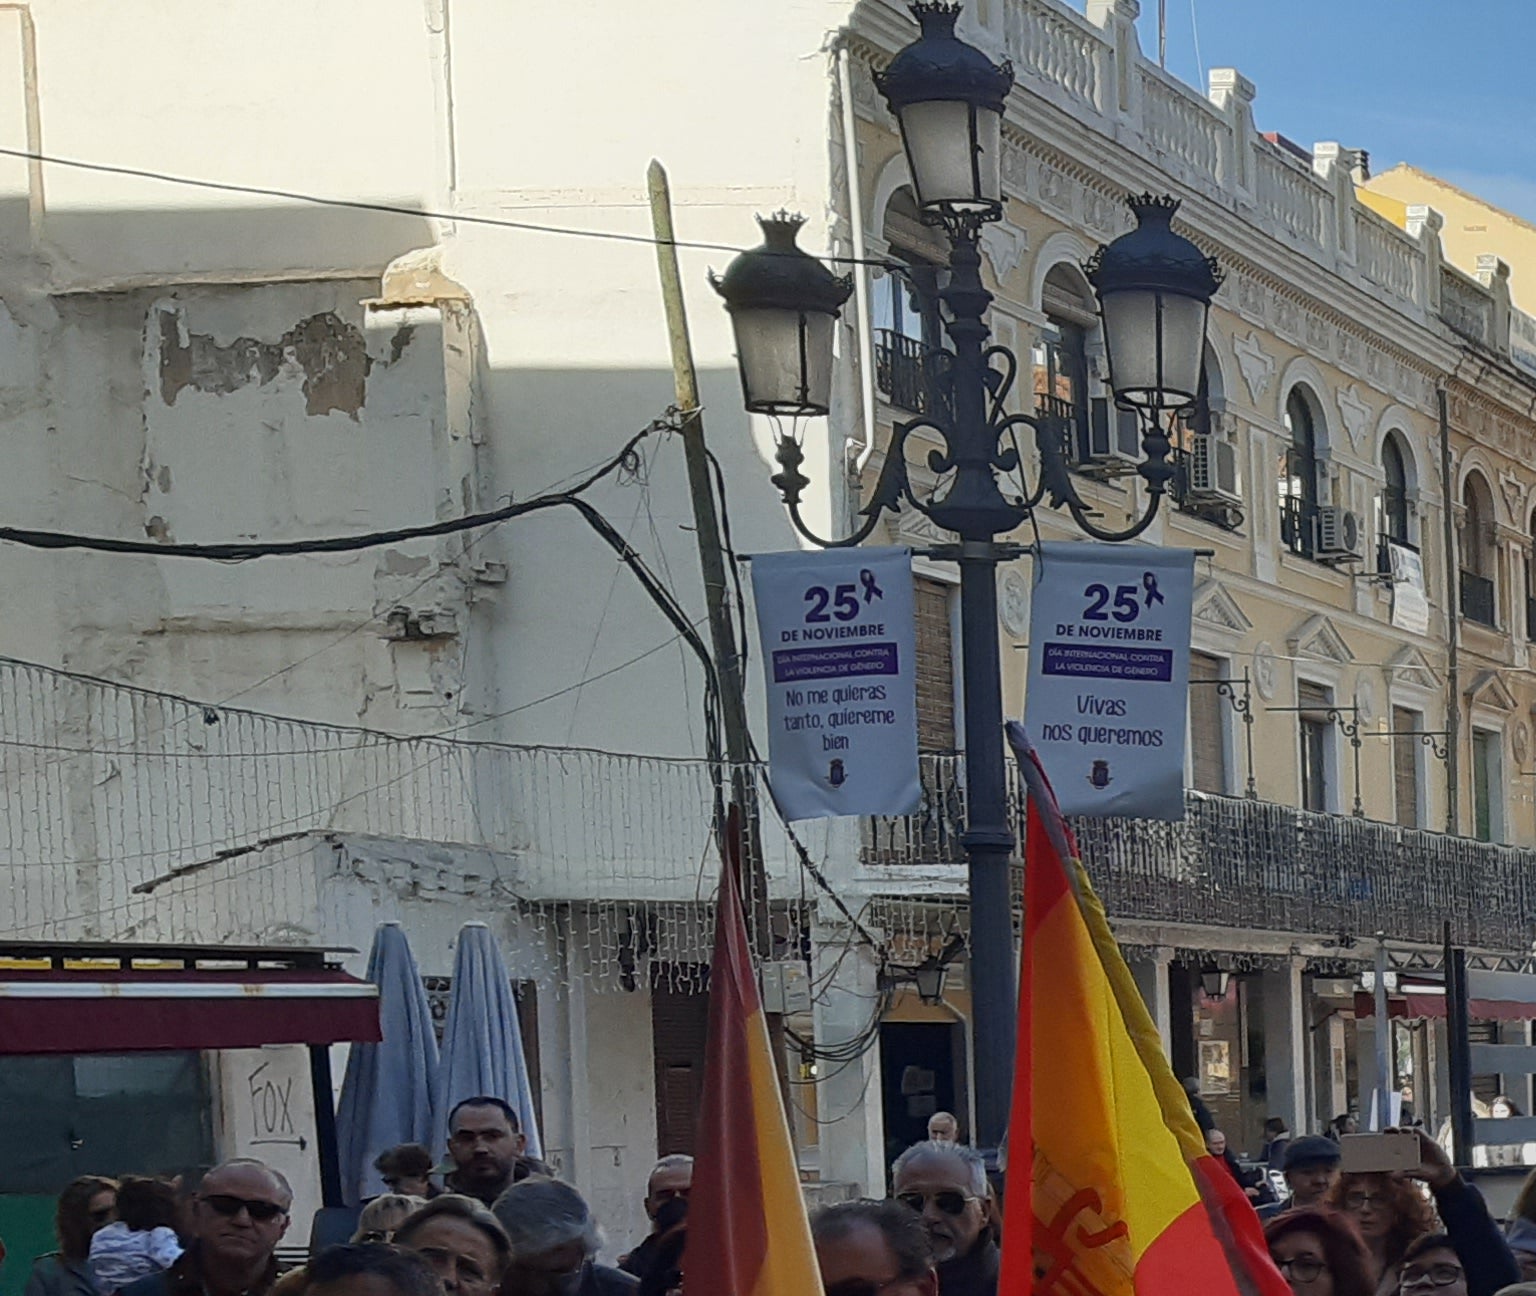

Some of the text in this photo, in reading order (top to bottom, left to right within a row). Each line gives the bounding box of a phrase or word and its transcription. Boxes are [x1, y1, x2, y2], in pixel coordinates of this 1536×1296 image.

[804, 584, 860, 623] 25
[1082, 583, 1140, 622] 25
[781, 624, 885, 642] DE NOVIEMBRE
[1056, 624, 1163, 642] DE NOVIEMBRE
[792, 650, 853, 663] INTERNACIONAL
[854, 648, 890, 658] CONTRA
[1064, 648, 1129, 662] INTERNACIONAL
[1130, 653, 1166, 663] CONTRA
[796, 664, 838, 676] VIOLENCIA
[840, 663, 849, 672] DE
[1055, 662, 1066, 671] LA
[1066, 662, 1110, 673] VIOLENCIA
[1111, 665, 1122, 674] DE
[786, 684, 887, 707] No me quieras
[1077, 694, 1127, 717] Vivas
[784, 712, 825, 731] tanto,
[822, 733, 849, 752] bien
[1042, 723, 1164, 747] nos queremos
[248, 1061, 294, 1137] FOX
